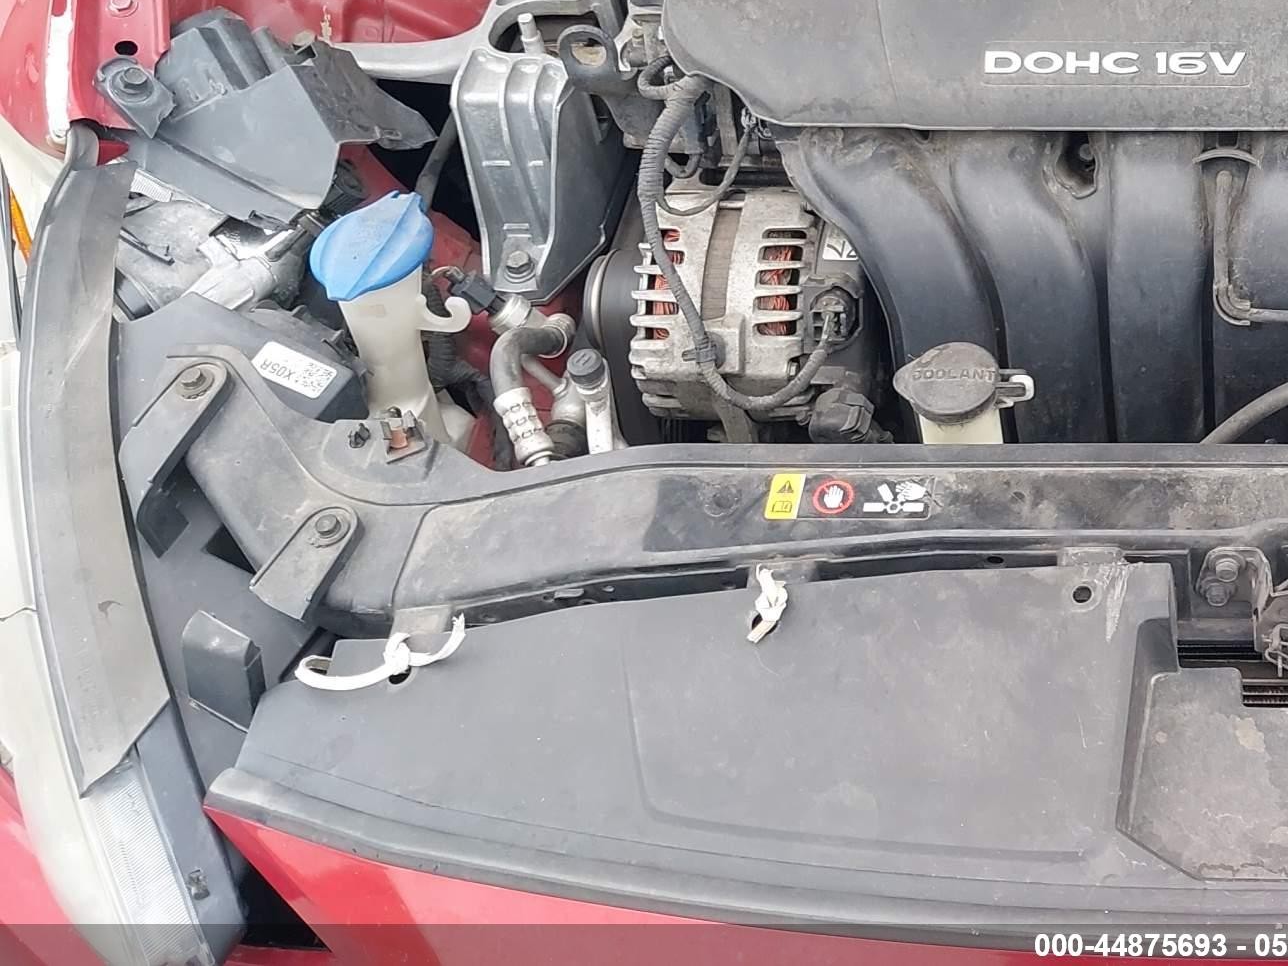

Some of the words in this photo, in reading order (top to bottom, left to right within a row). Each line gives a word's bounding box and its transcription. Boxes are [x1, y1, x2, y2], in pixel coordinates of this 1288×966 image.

[984, 50, 1140, 76] DOHC
[1155, 51, 1247, 76] 16V
[260, 358, 296, 381] X05R
[912, 368, 996, 381] COOLANT
